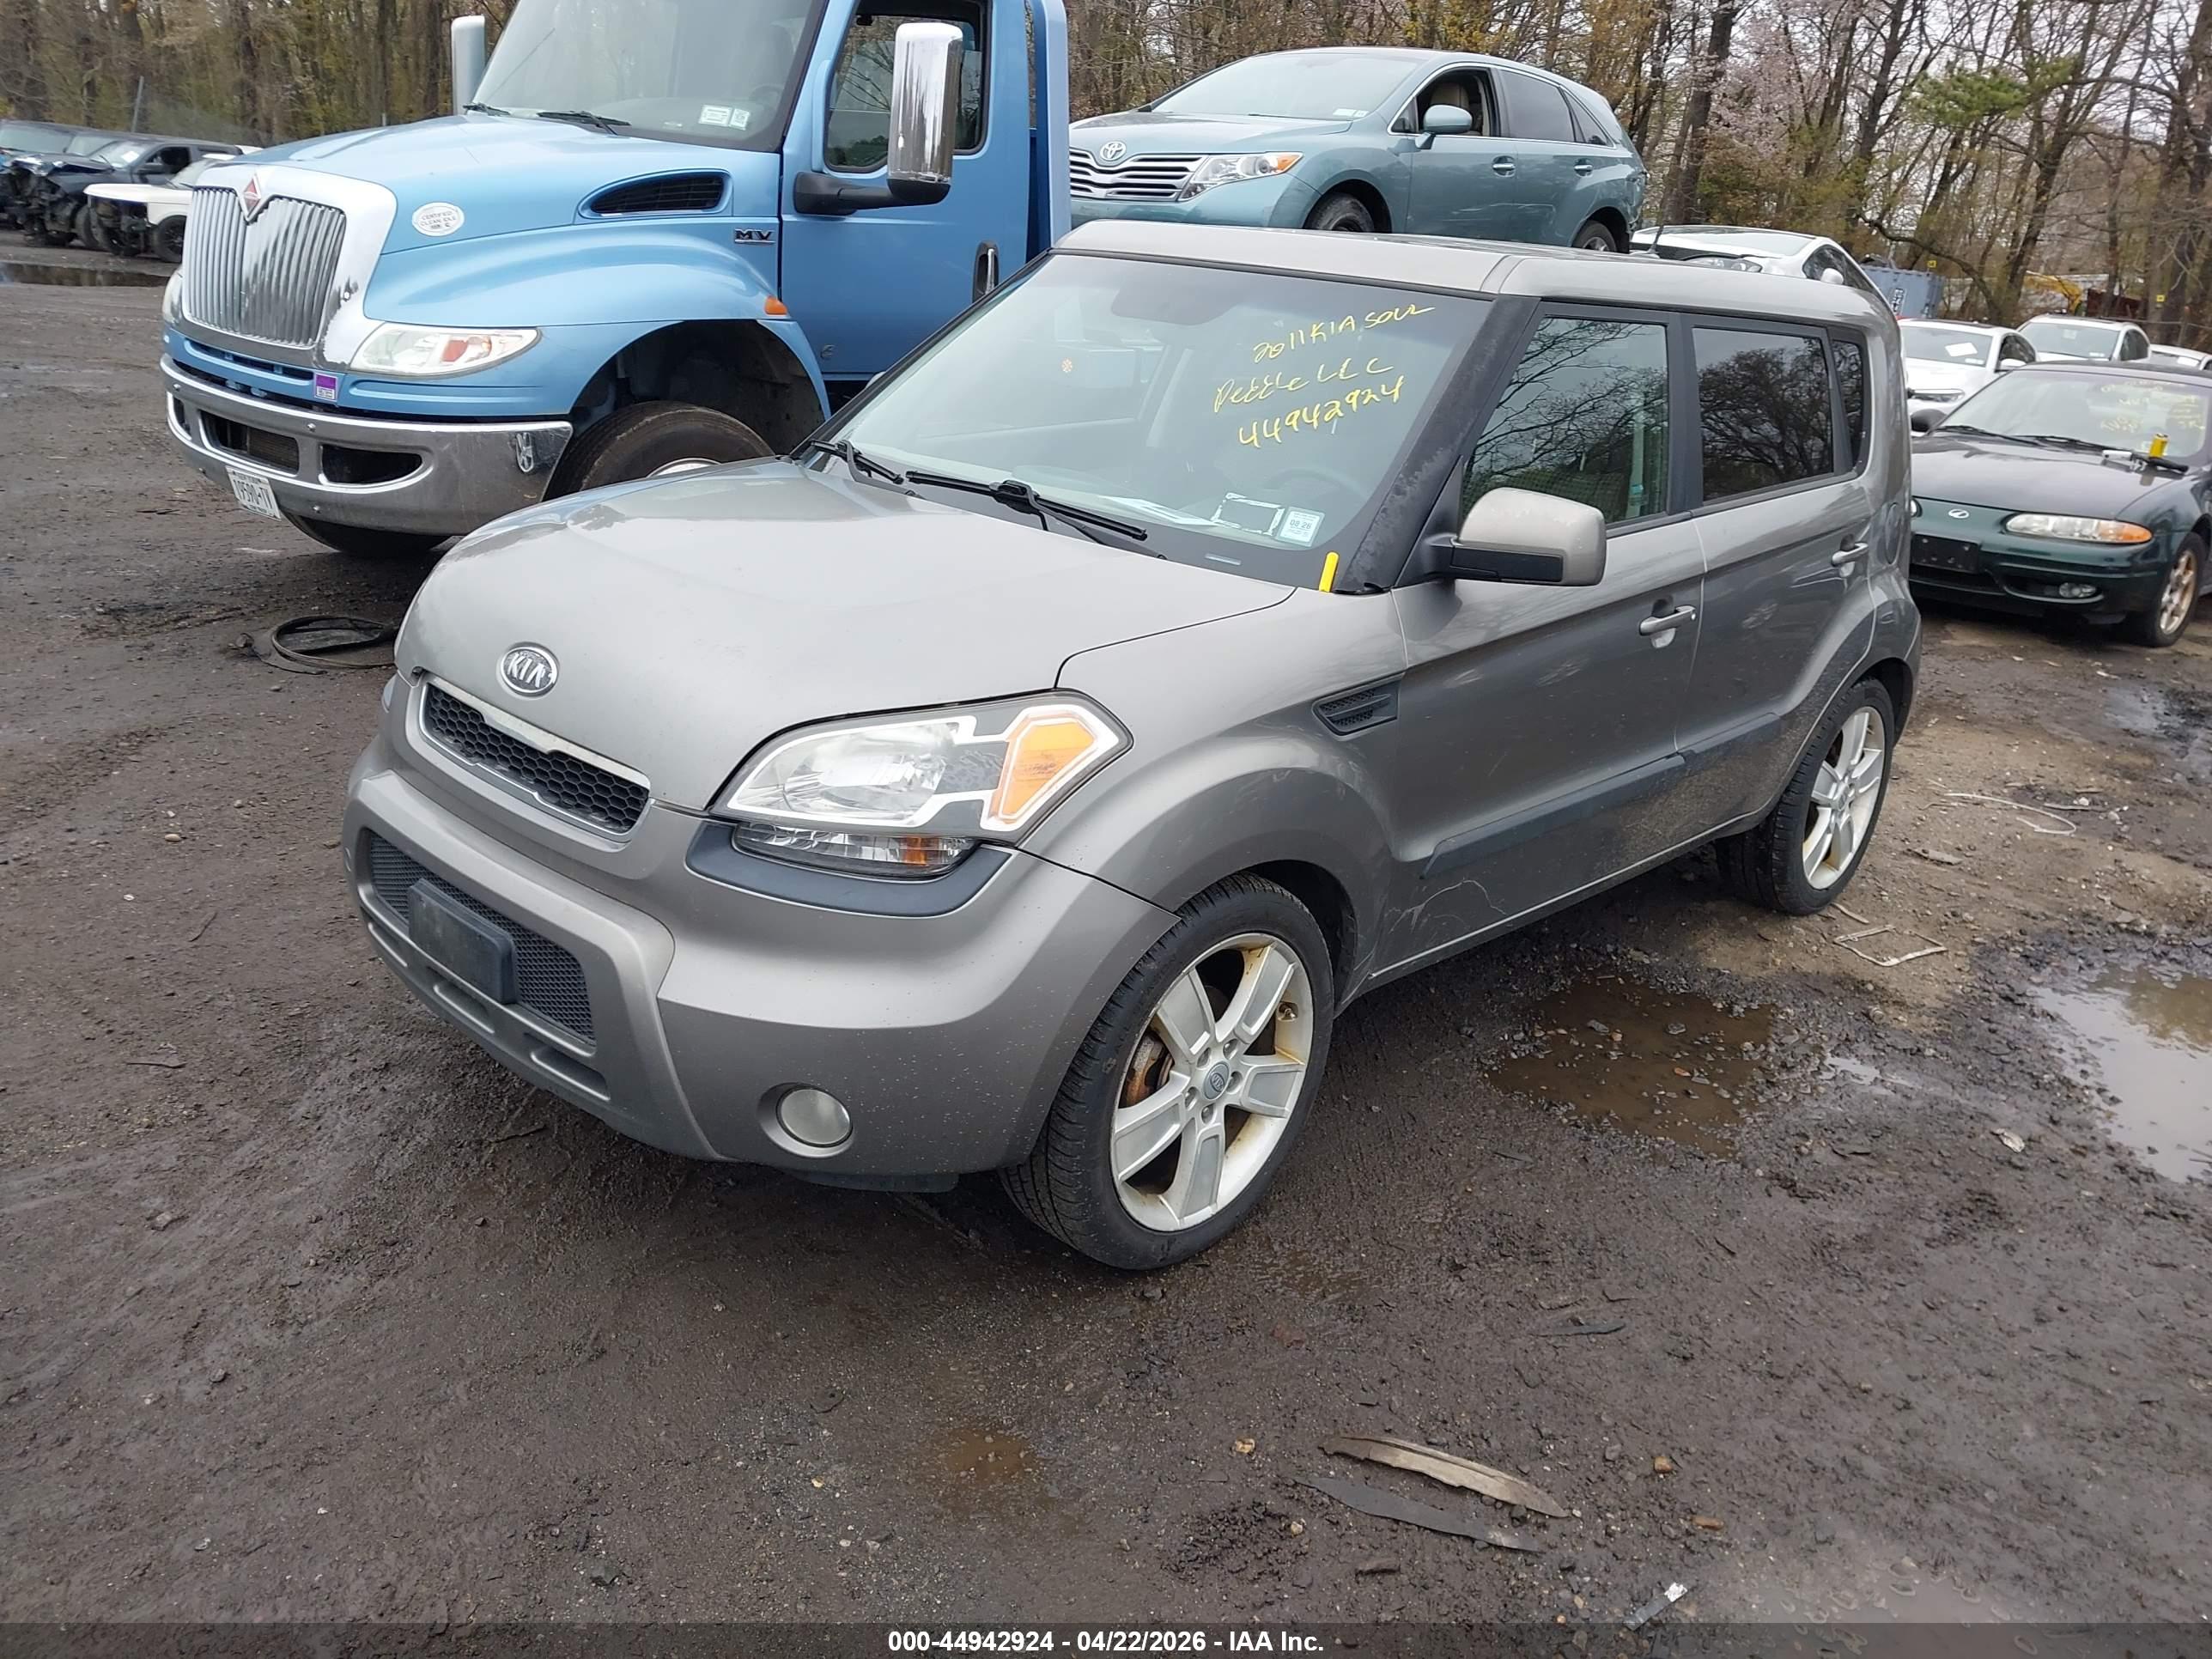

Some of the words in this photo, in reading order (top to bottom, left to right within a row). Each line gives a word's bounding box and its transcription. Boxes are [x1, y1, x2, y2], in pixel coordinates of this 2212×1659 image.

[734, 228, 775, 242] MV
[1238, 374, 1405, 448] 44942924
[507, 652, 546, 689] KIA
